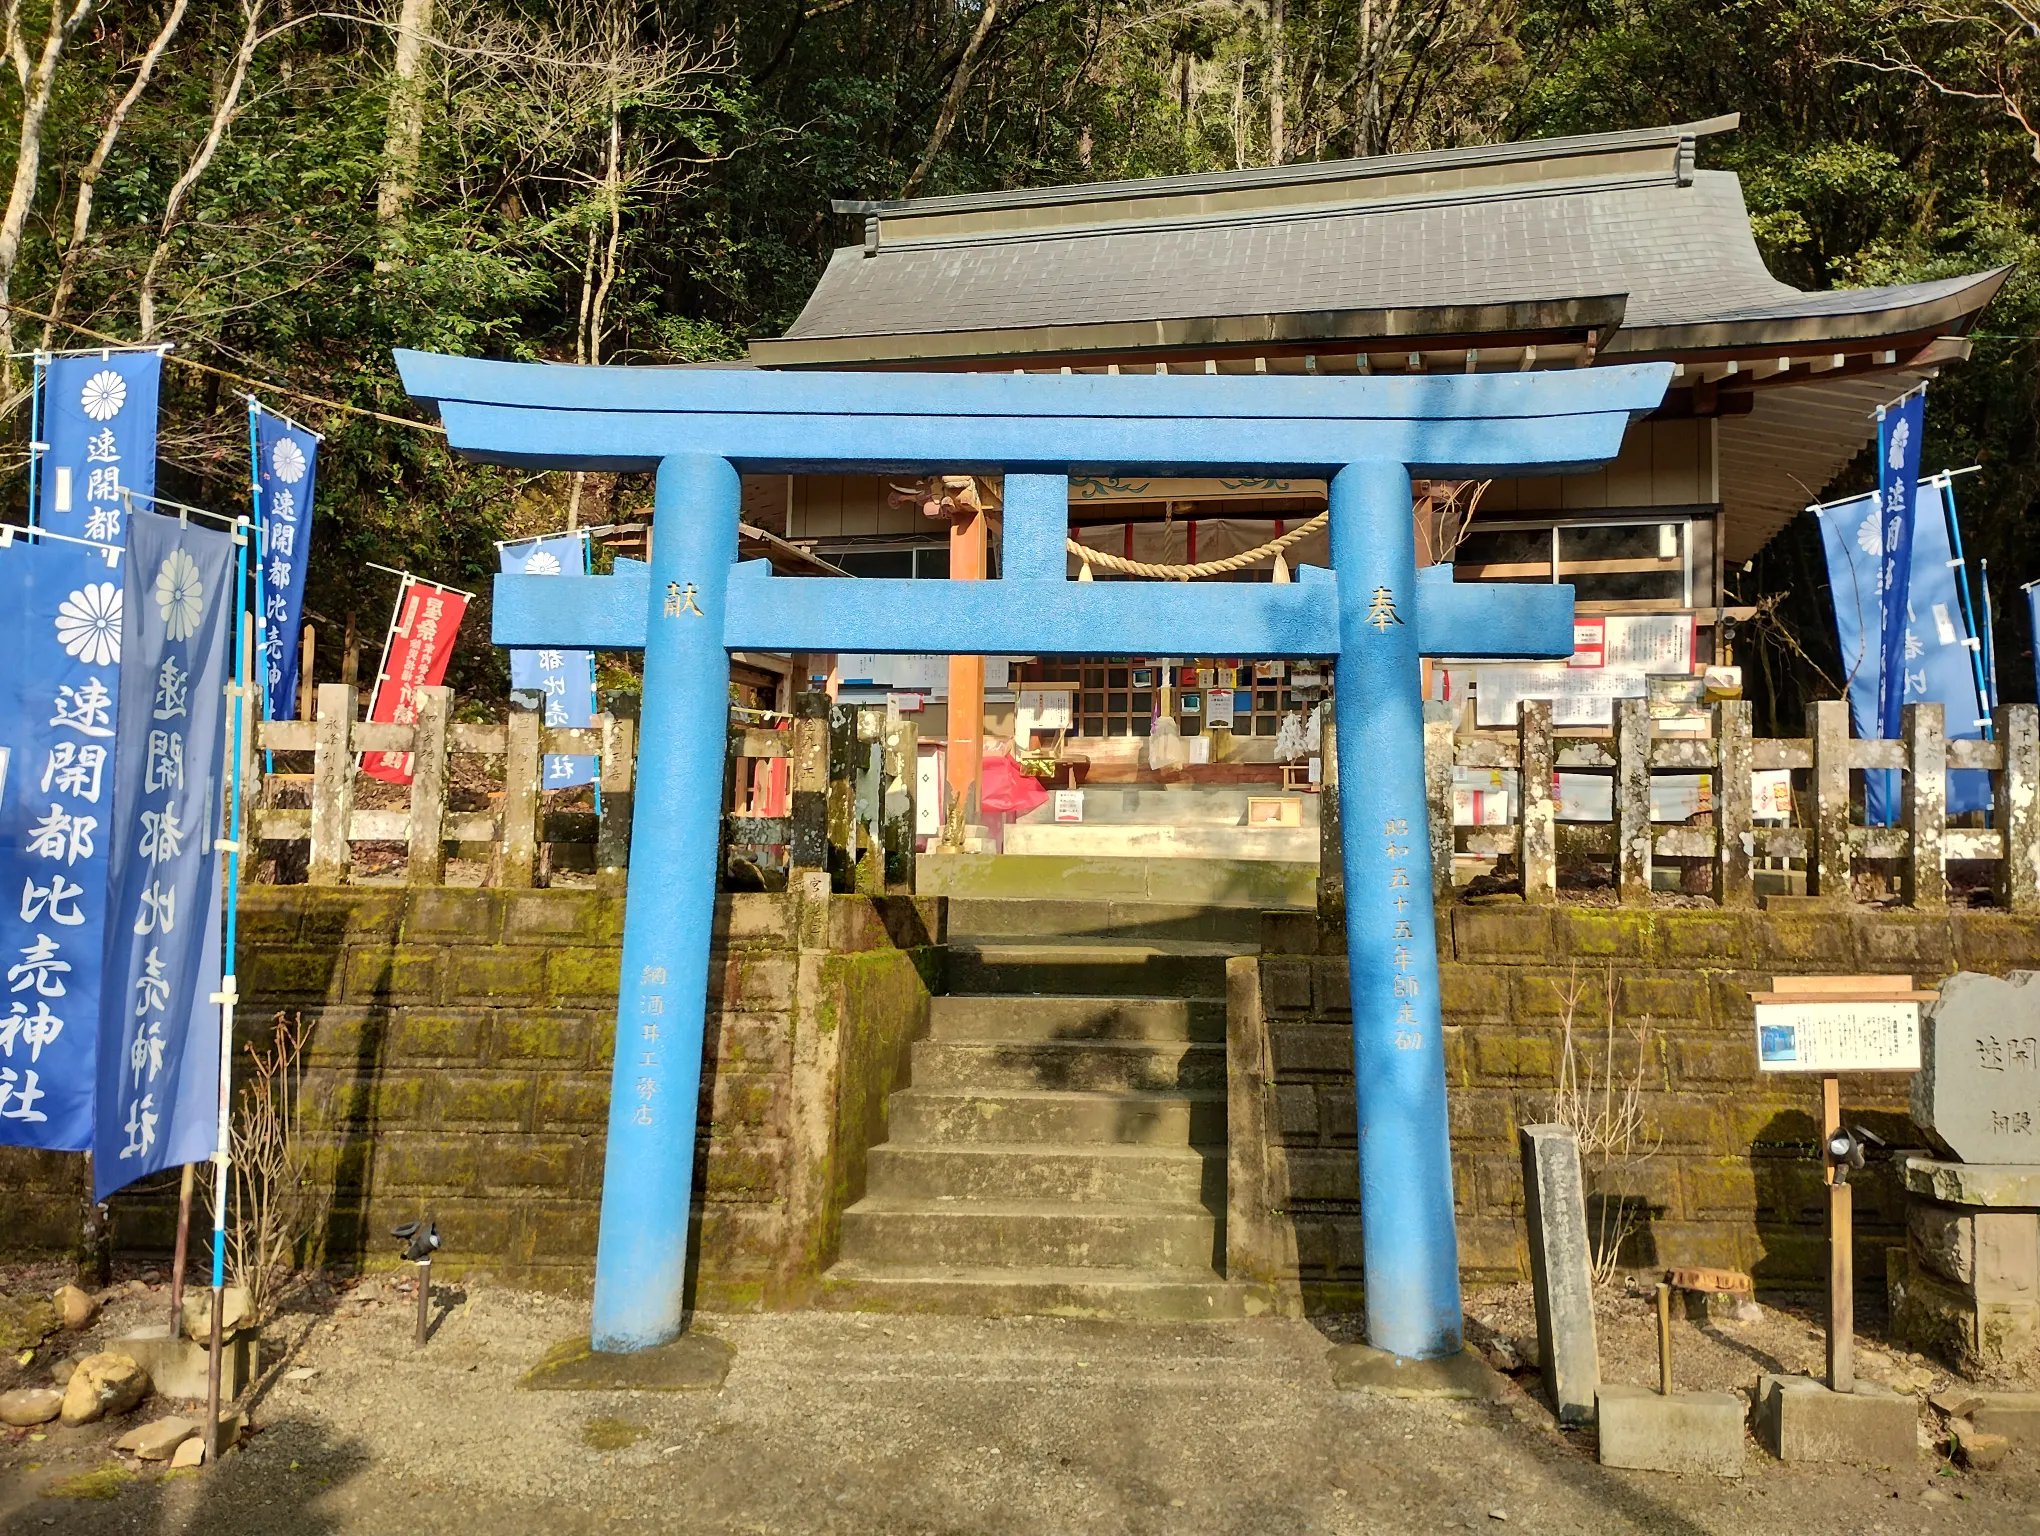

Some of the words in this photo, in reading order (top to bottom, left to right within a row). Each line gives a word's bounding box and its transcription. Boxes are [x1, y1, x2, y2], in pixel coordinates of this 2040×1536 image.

[84, 427, 122, 557] 速開都
[664, 580, 704, 619] 献
[1363, 585, 1405, 633] 奉
[0, 676, 116, 1123] 速開都比売神社
